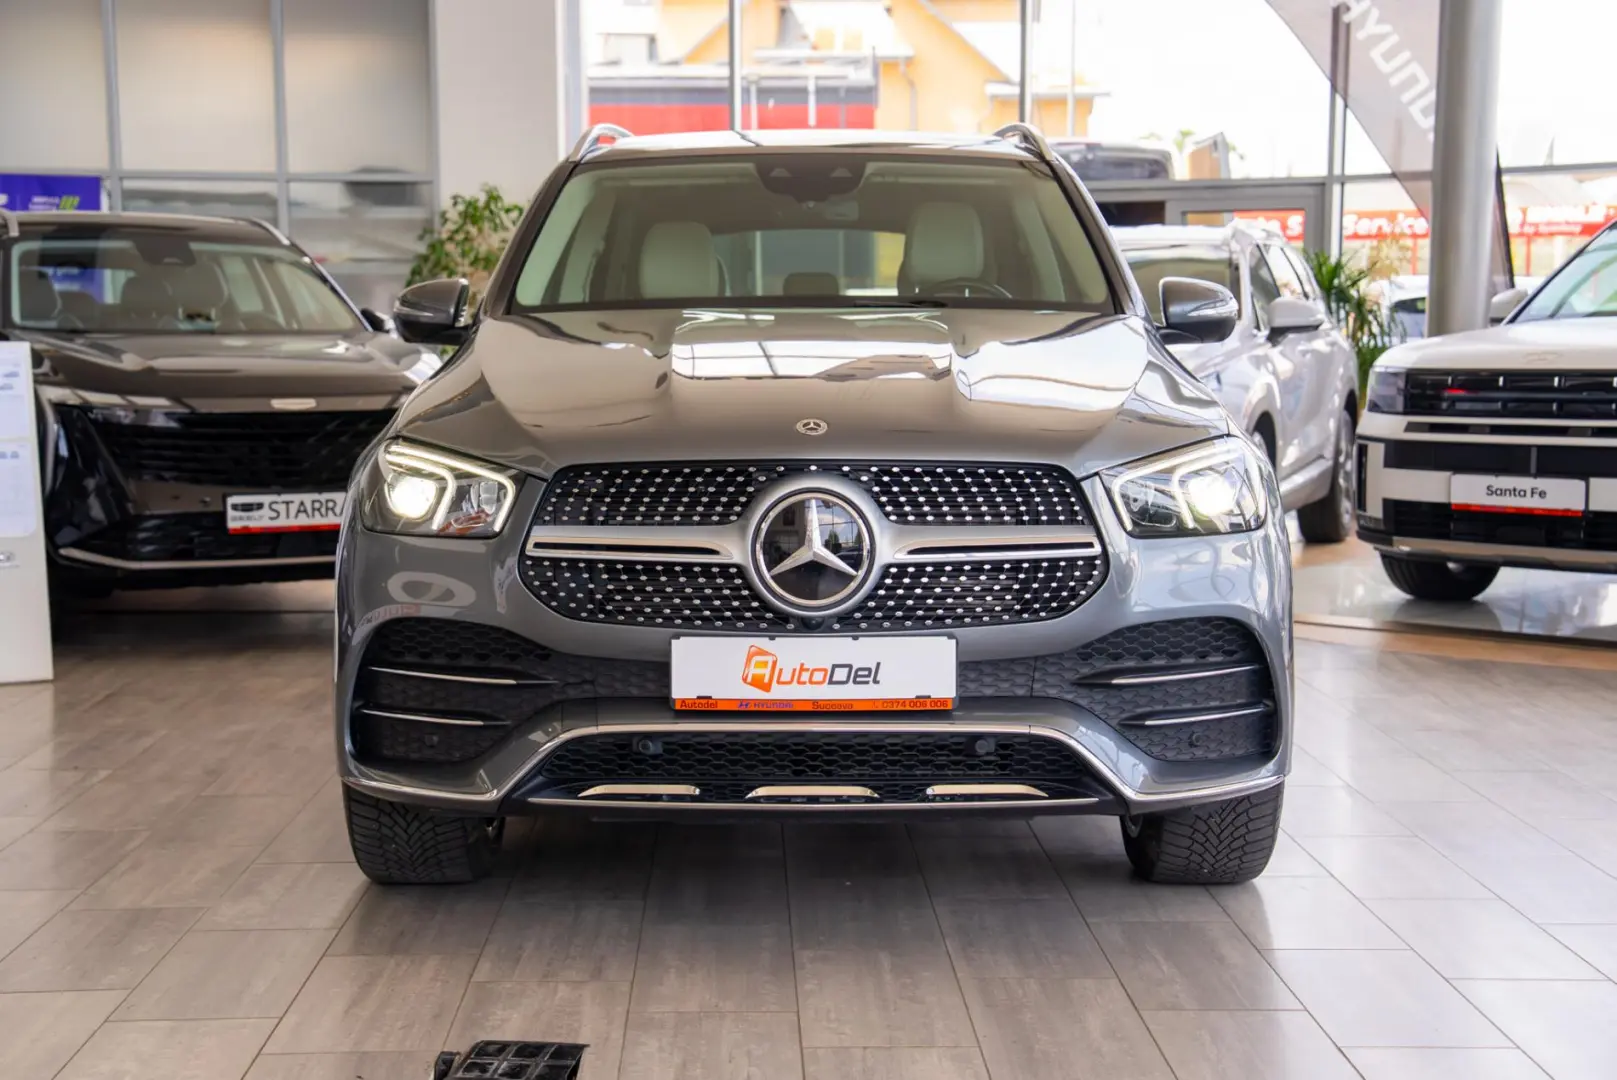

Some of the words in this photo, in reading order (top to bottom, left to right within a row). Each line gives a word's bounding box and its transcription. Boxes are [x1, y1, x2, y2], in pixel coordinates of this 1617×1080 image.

[1331, 0, 1437, 138] HYUND
[1486, 484, 1527, 498] Santa
[1530, 487, 1547, 499] Fe
[268, 499, 345, 521] STARR
[742, 648, 881, 690] AutoDel
[680, 700, 718, 709] Autodel
